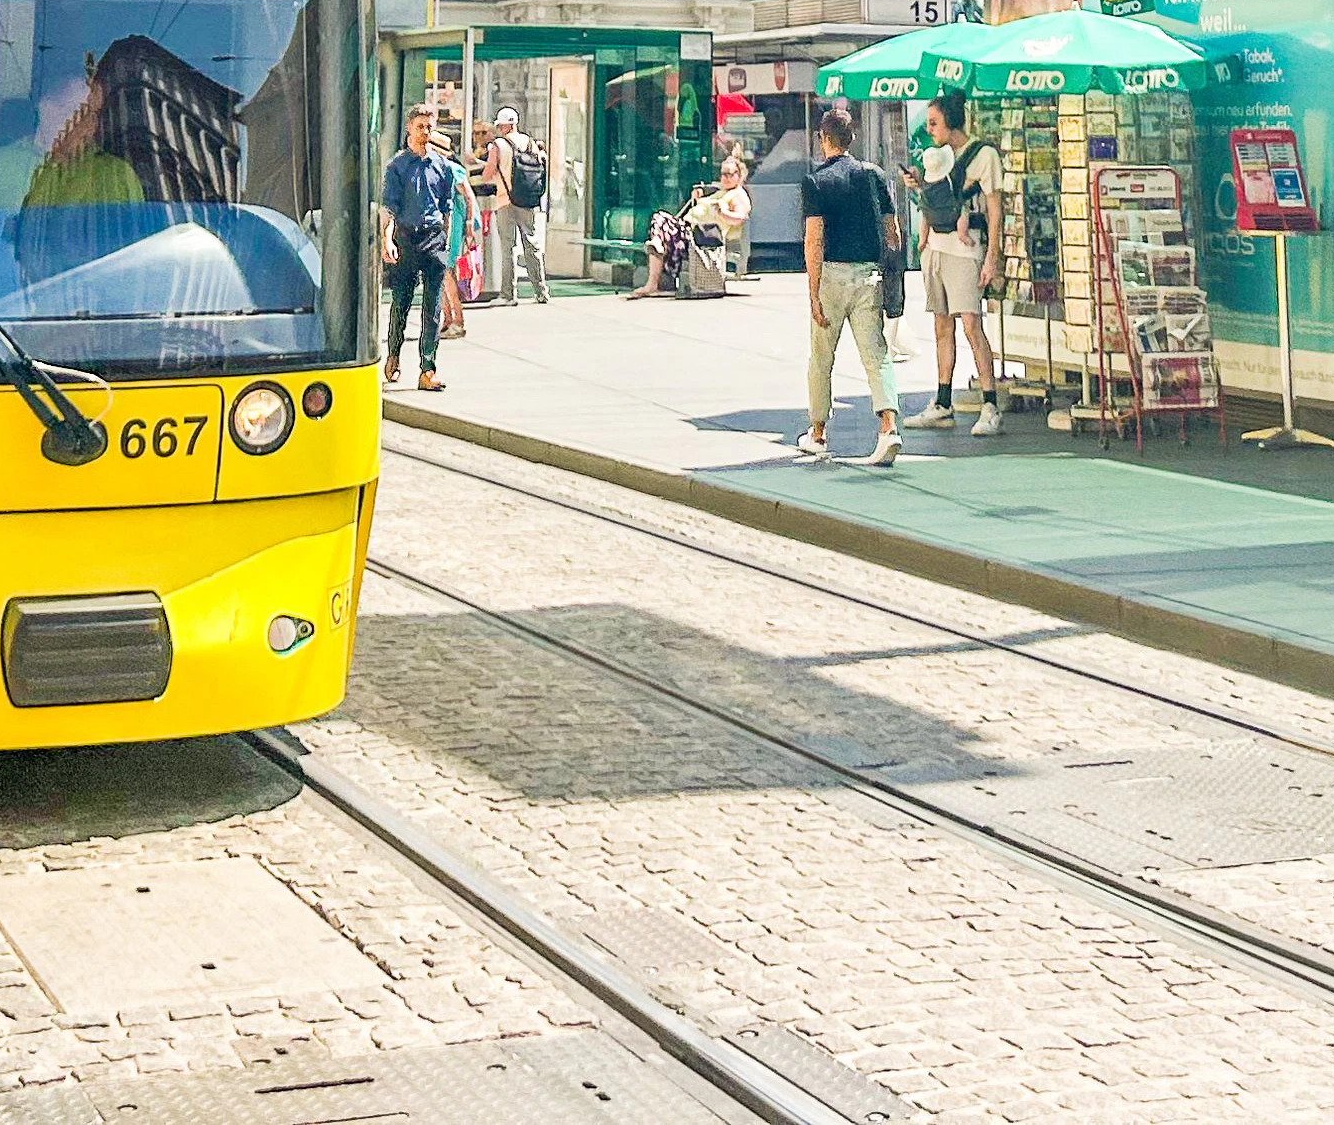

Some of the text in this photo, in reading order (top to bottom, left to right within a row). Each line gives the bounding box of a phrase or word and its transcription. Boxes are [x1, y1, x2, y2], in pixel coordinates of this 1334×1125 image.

[909, 0, 939, 23] 15
[1243, 47, 1276, 65] Tabak,
[935, 57, 964, 81] LOTTO
[1005, 69, 1065, 91] LOTTO
[869, 76, 919, 98] LOTTO
[120, 415, 208, 459] 667
